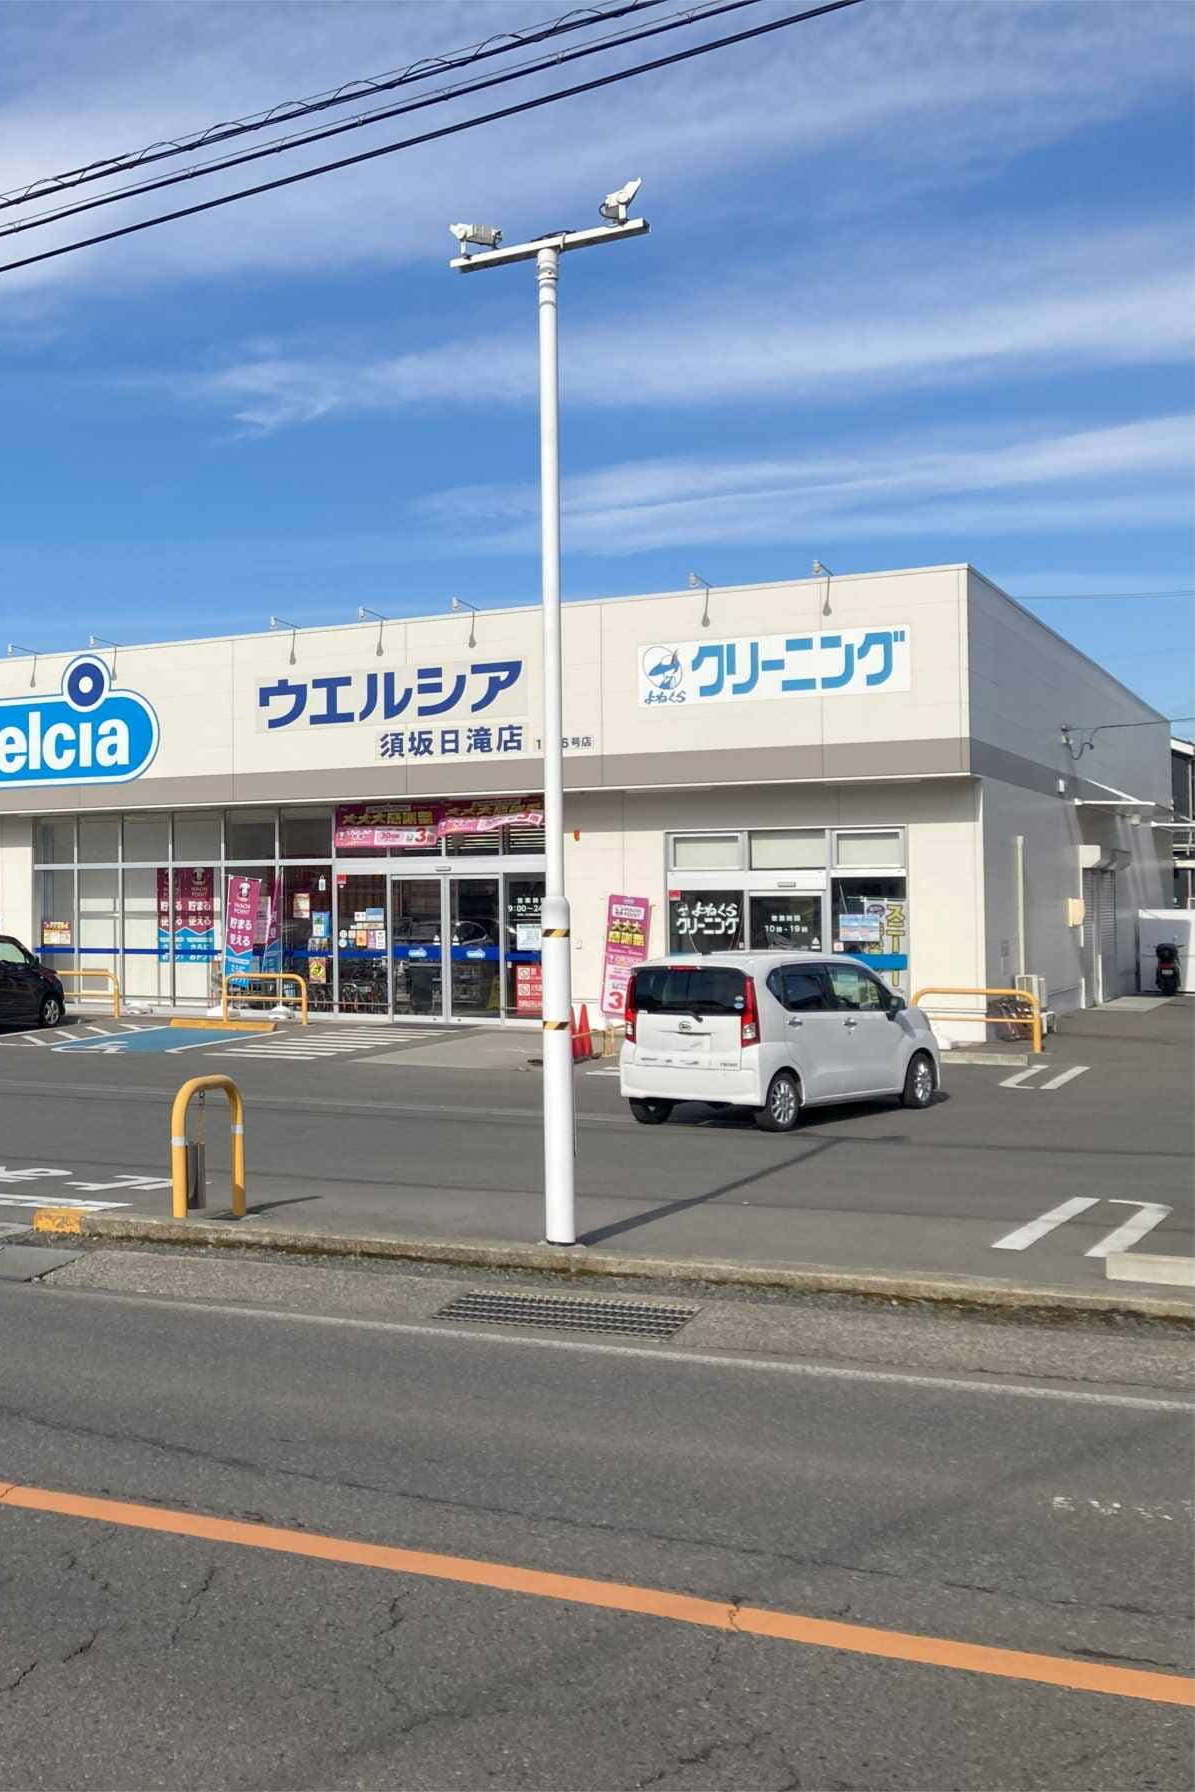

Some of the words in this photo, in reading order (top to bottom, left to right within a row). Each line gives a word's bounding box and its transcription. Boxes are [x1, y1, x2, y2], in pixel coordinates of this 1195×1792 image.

[691, 630, 905, 697] クリーニング
[259, 660, 523, 729] ウエルシア
[380, 725, 523, 758] 須坂日滝店
[676, 917, 740, 934] クリーニング
[692, 902, 738, 917] よねくら
